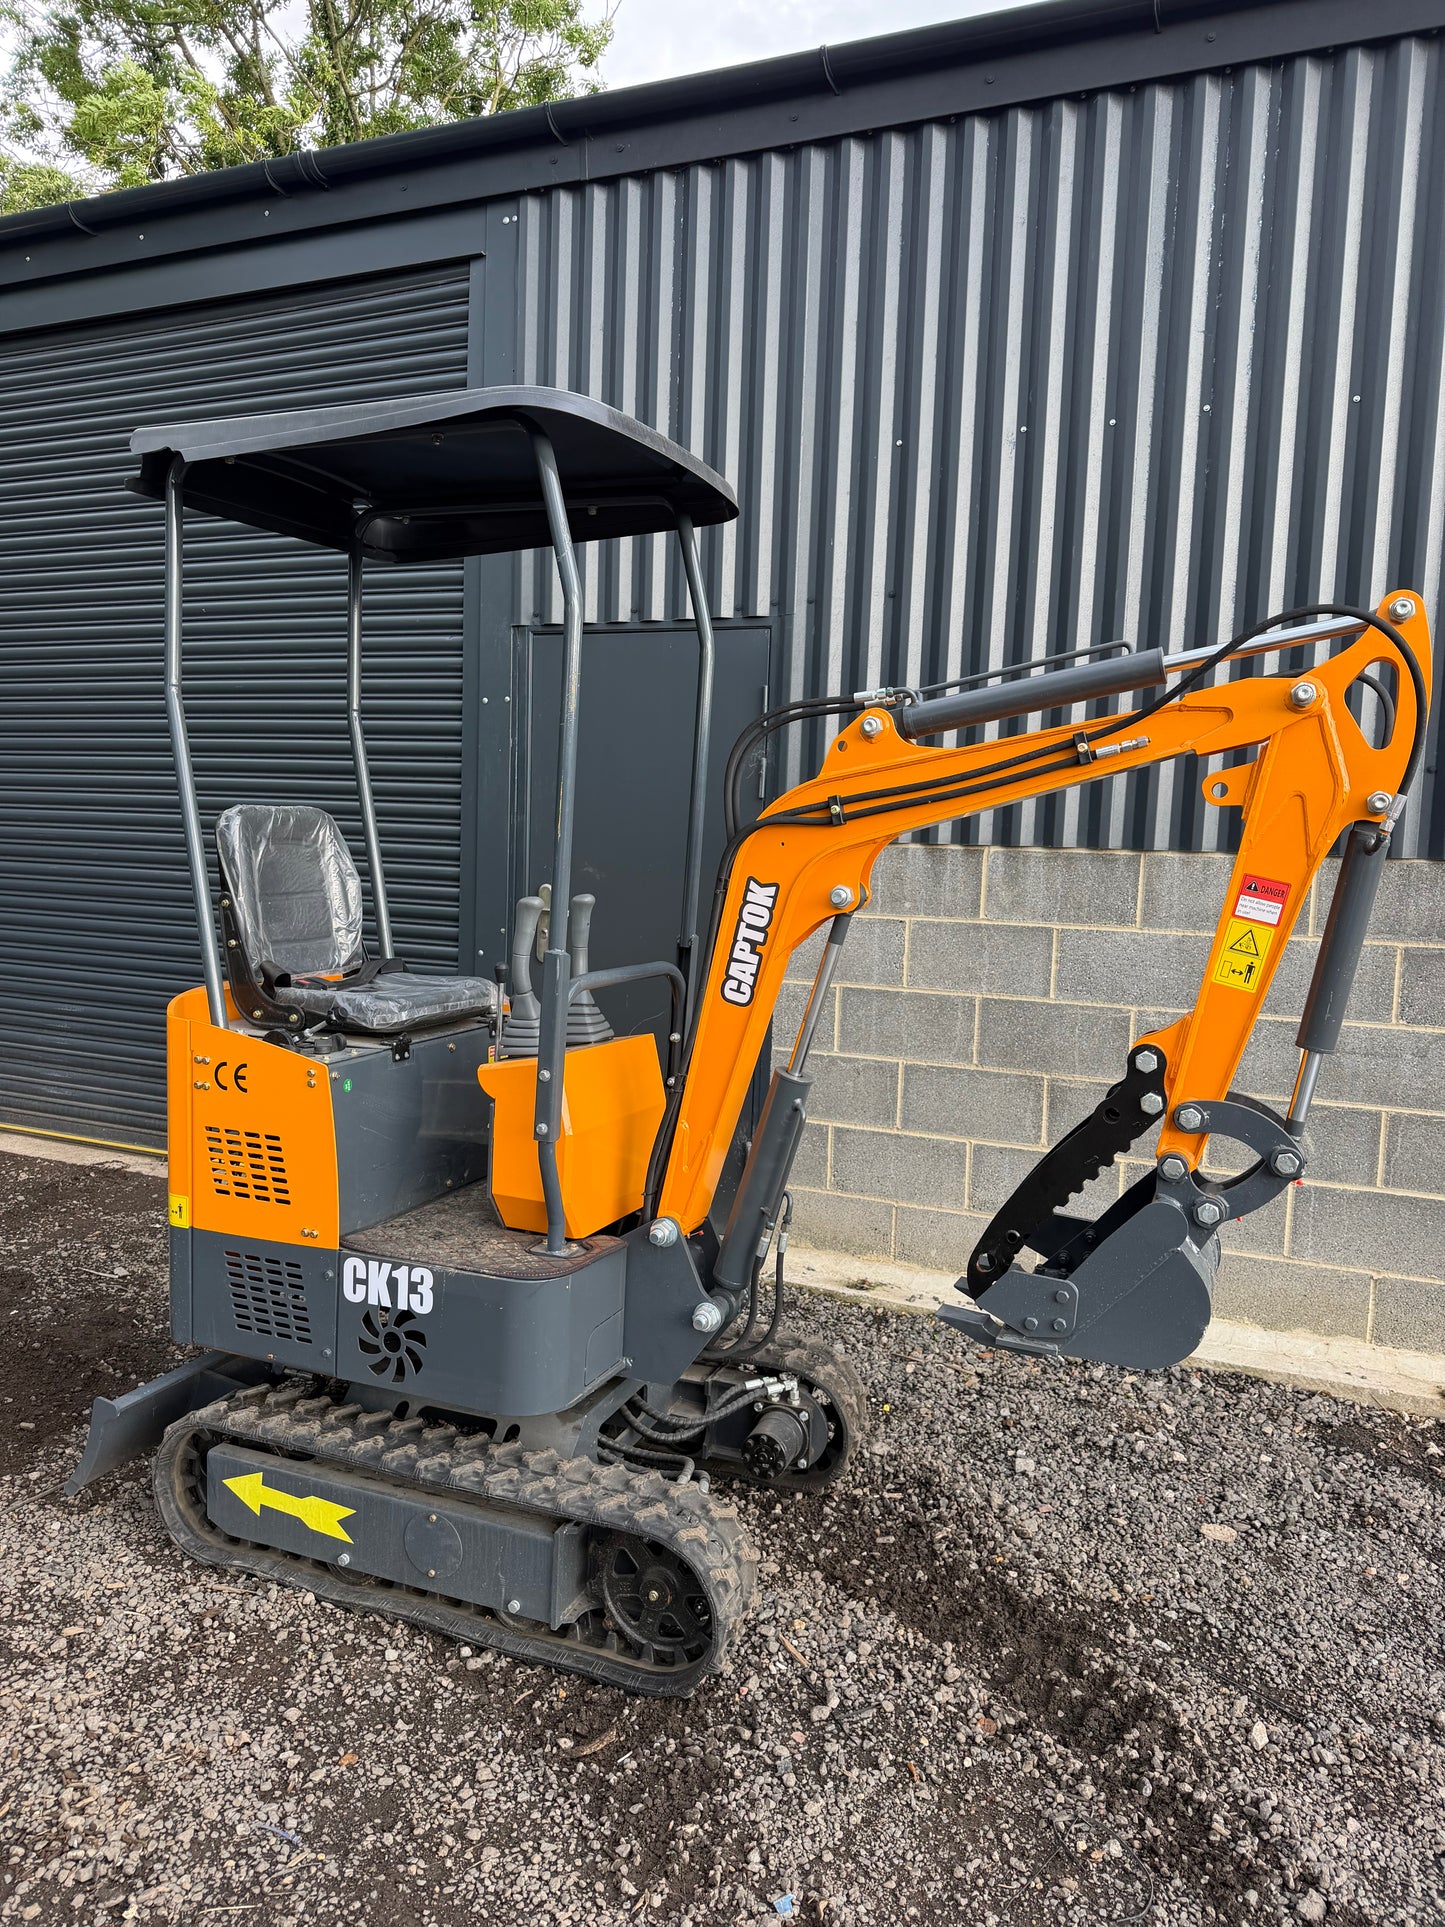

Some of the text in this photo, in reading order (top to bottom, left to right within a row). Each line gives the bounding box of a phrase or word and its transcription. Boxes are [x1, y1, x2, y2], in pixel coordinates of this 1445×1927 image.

[1260, 885, 1285, 898] DANGER
[721, 877, 779, 1006] CAPTOK
[214, 1061, 248, 1093] CE
[343, 1257, 434, 1314] CK13
